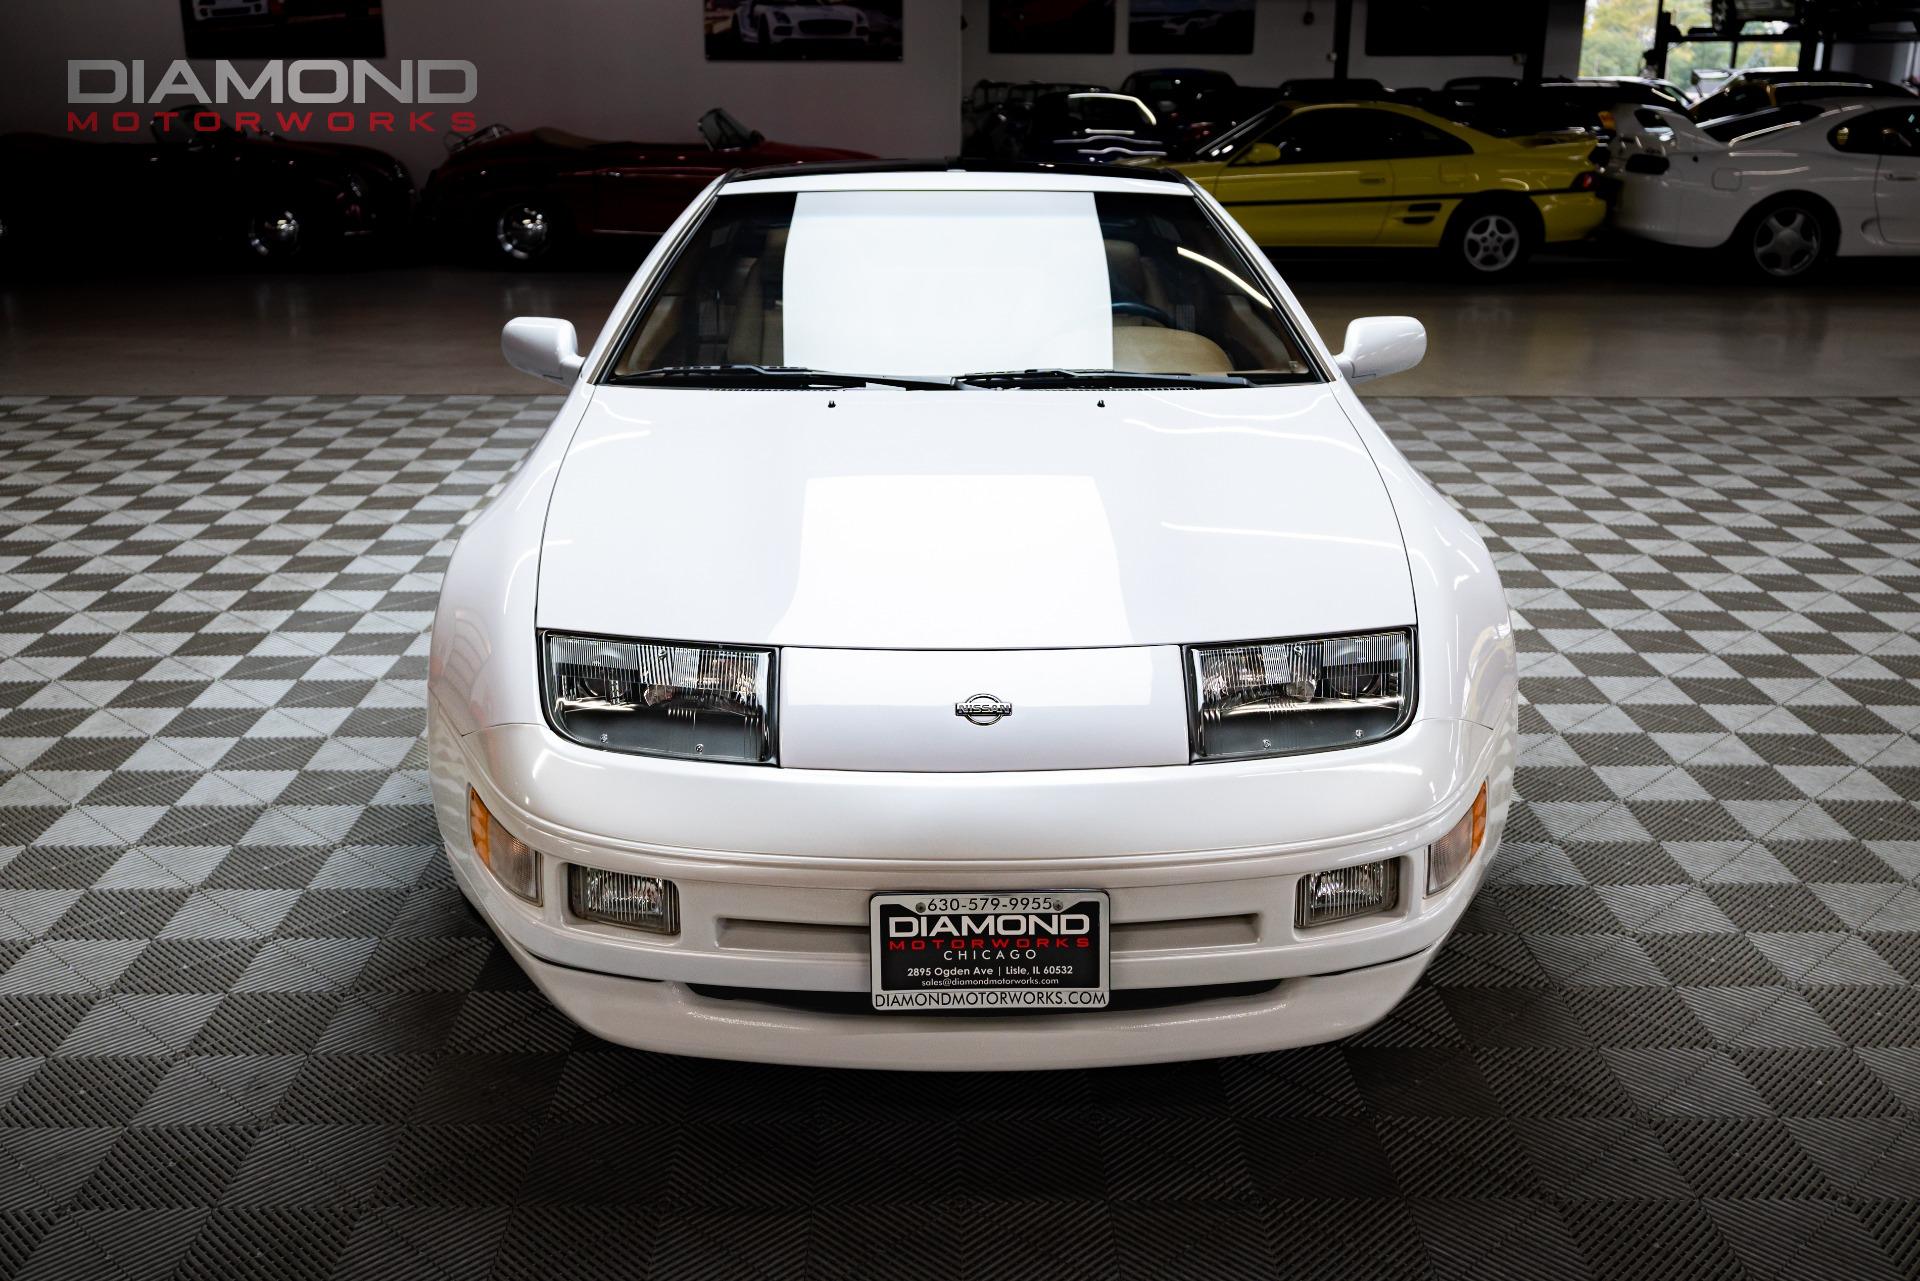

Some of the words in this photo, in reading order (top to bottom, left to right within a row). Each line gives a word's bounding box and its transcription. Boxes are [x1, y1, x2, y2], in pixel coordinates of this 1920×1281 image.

[958, 704, 1010, 714] NISSAN
[927, 897, 1052, 912] 630-579-9955
[888, 914, 1090, 938] DIAMOND
[889, 937, 1090, 951] MOTORWORKS
[943, 949, 1037, 961] CHICAGO
[907, 967, 932, 977] 2895
[934, 966, 970, 978] Ogden
[973, 966, 994, 976] Ave
[1032, 965, 1041, 975] IL
[1043, 965, 1073, 975] 60532
[921, 976, 1059, 987] sales@diamondmotorworks.com
[875, 990, 1107, 1008] DIAMONDMOTORWORKS.COM
